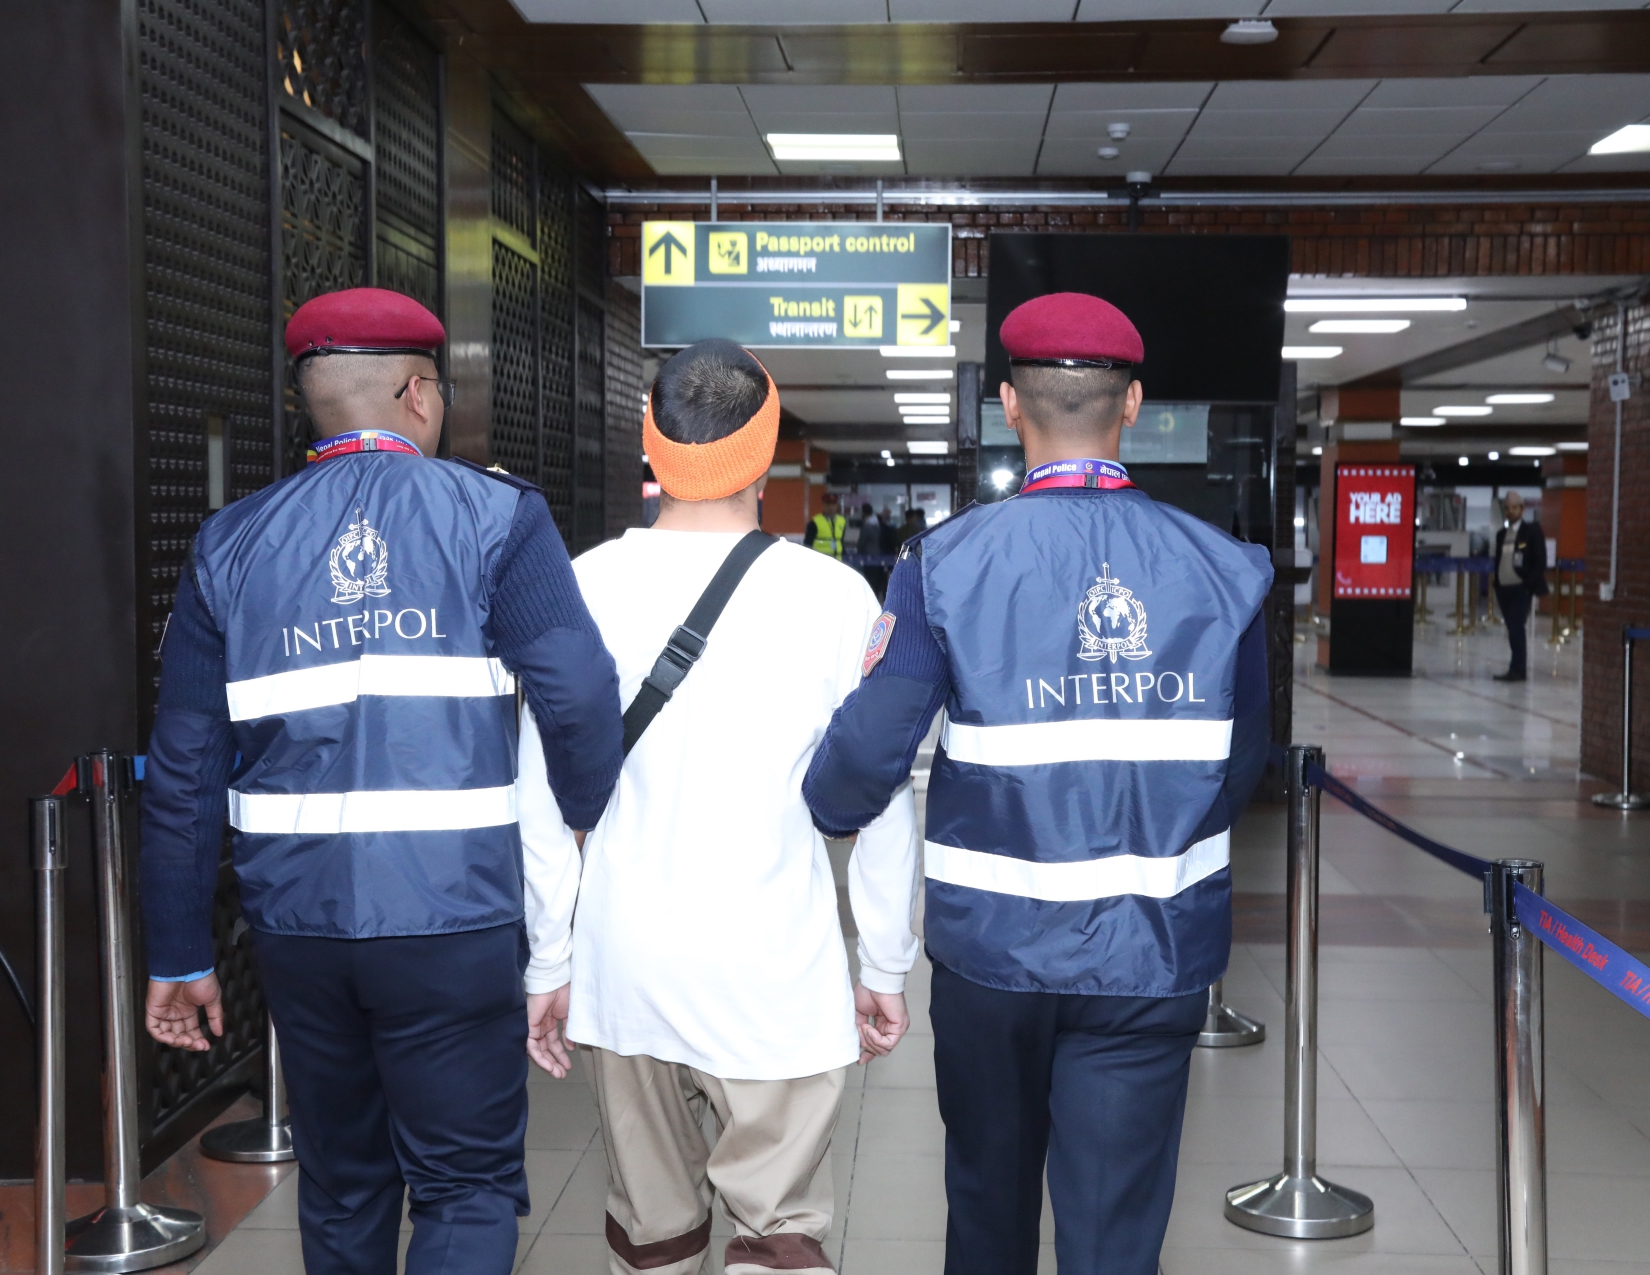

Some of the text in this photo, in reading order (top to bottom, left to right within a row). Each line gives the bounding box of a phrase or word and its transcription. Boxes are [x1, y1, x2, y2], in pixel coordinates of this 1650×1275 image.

[756, 232, 915, 255] Passport control
[769, 297, 836, 317] Transit
[1033, 463, 1077, 481] Nepal Police
[1099, 464, 1121, 479] नेपाल
[1349, 492, 1402, 504] YOUR AD
[1349, 503, 1402, 524] HERE
[1088, 584, 1129, 598] OIPC ICPO
[282, 607, 447, 657] INTERPOL
[1093, 638, 1132, 650] INTERPOL
[1025, 671, 1206, 709] INTERPOL
[1538, 909, 1553, 931] TIA
[1555, 923, 1584, 954] Health
[1581, 943, 1609, 971] Desk
[1619, 970, 1643, 994] TIA
